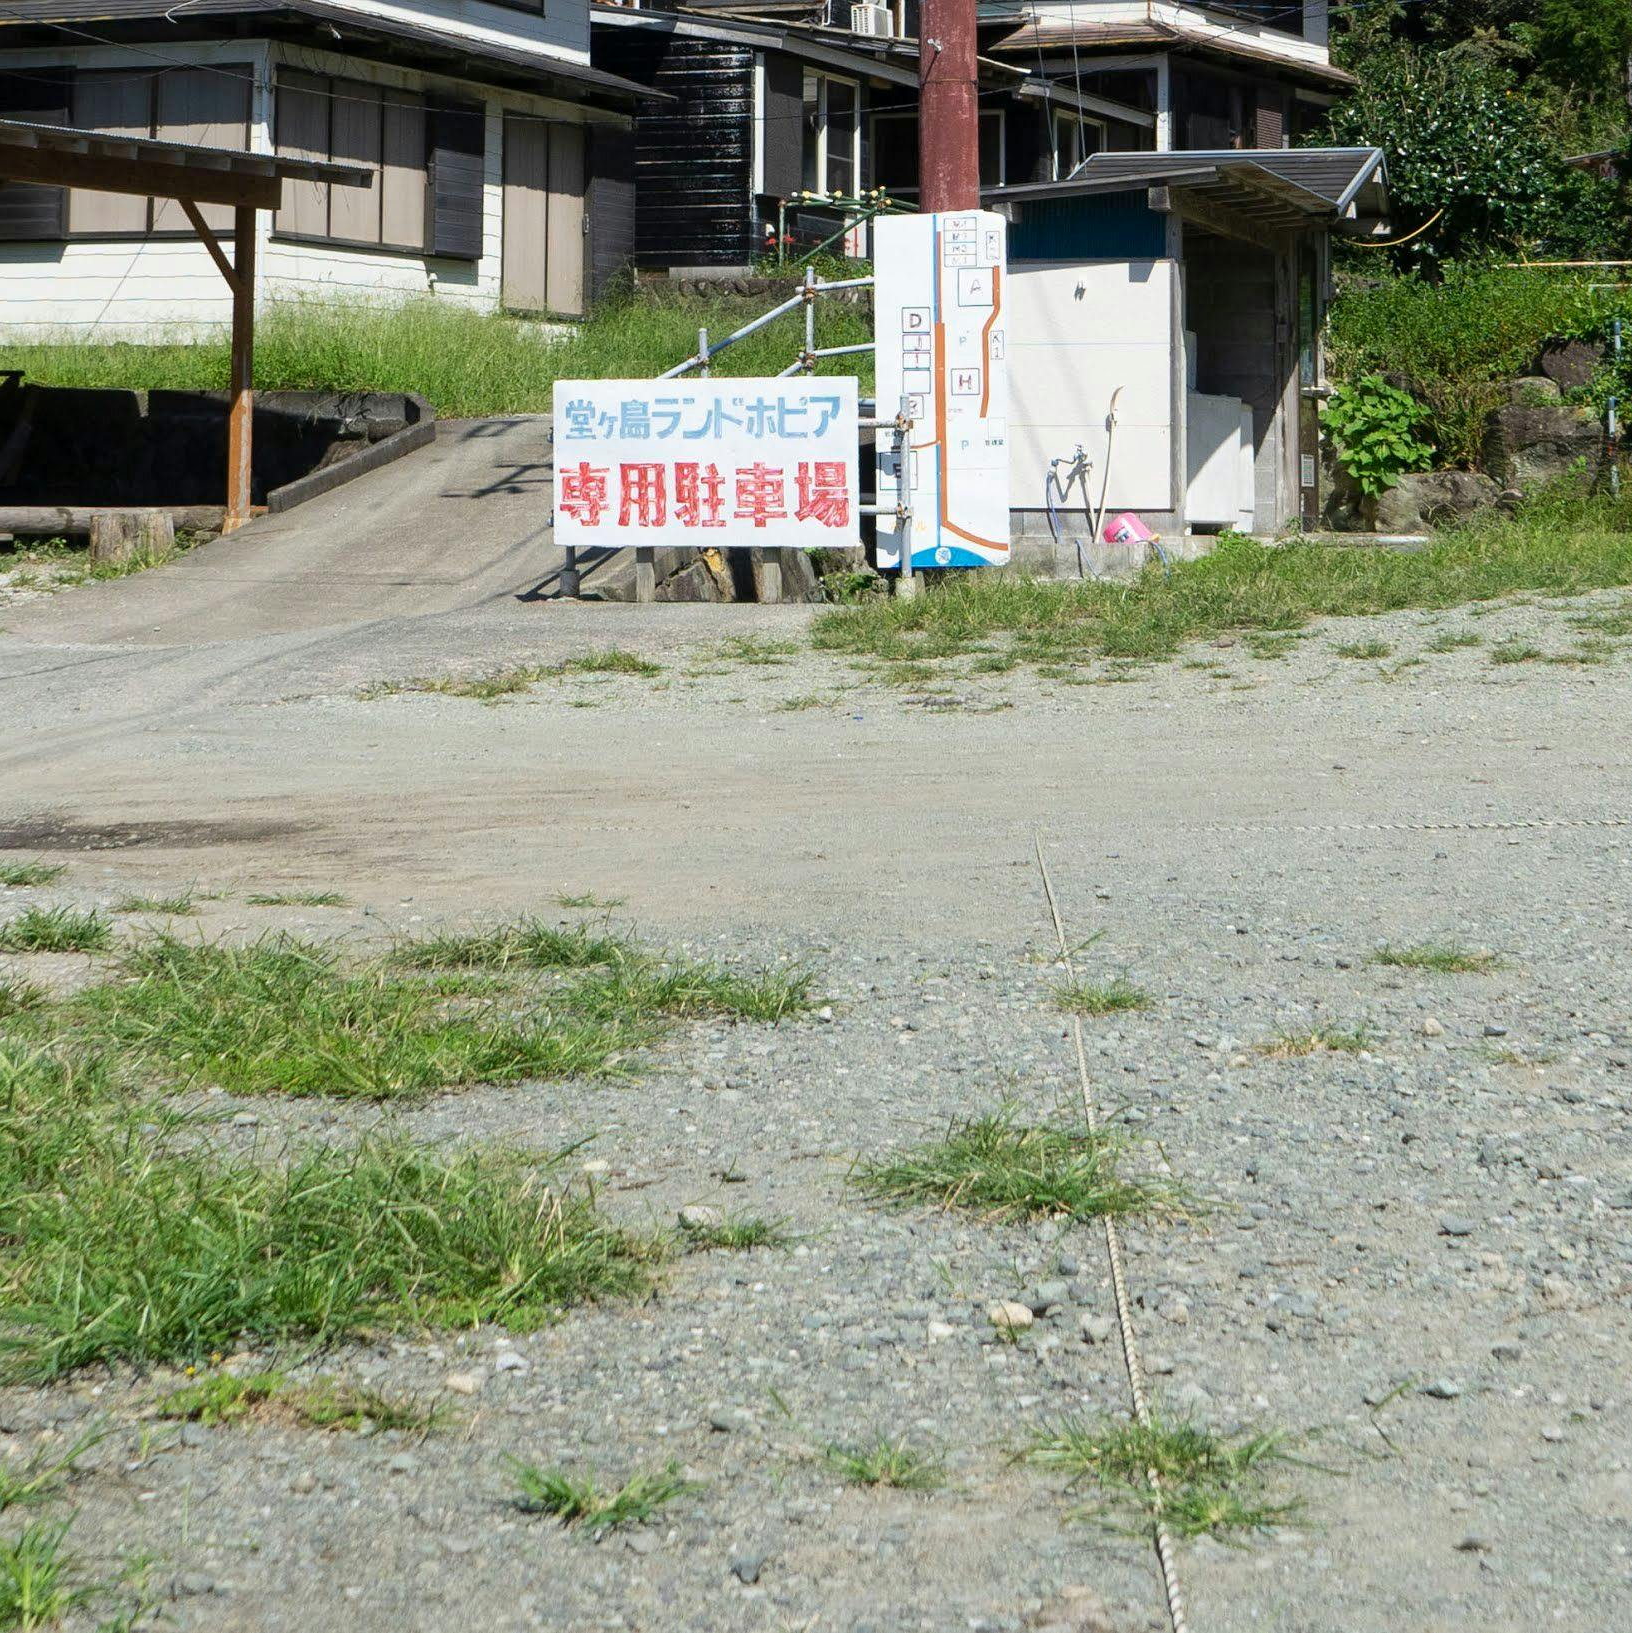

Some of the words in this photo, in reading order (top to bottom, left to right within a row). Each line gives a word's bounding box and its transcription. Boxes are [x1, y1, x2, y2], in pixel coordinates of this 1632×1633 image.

[909, 313, 922, 328] D
[959, 374, 972, 390] H
[560, 462, 850, 527] 専用駐車場
